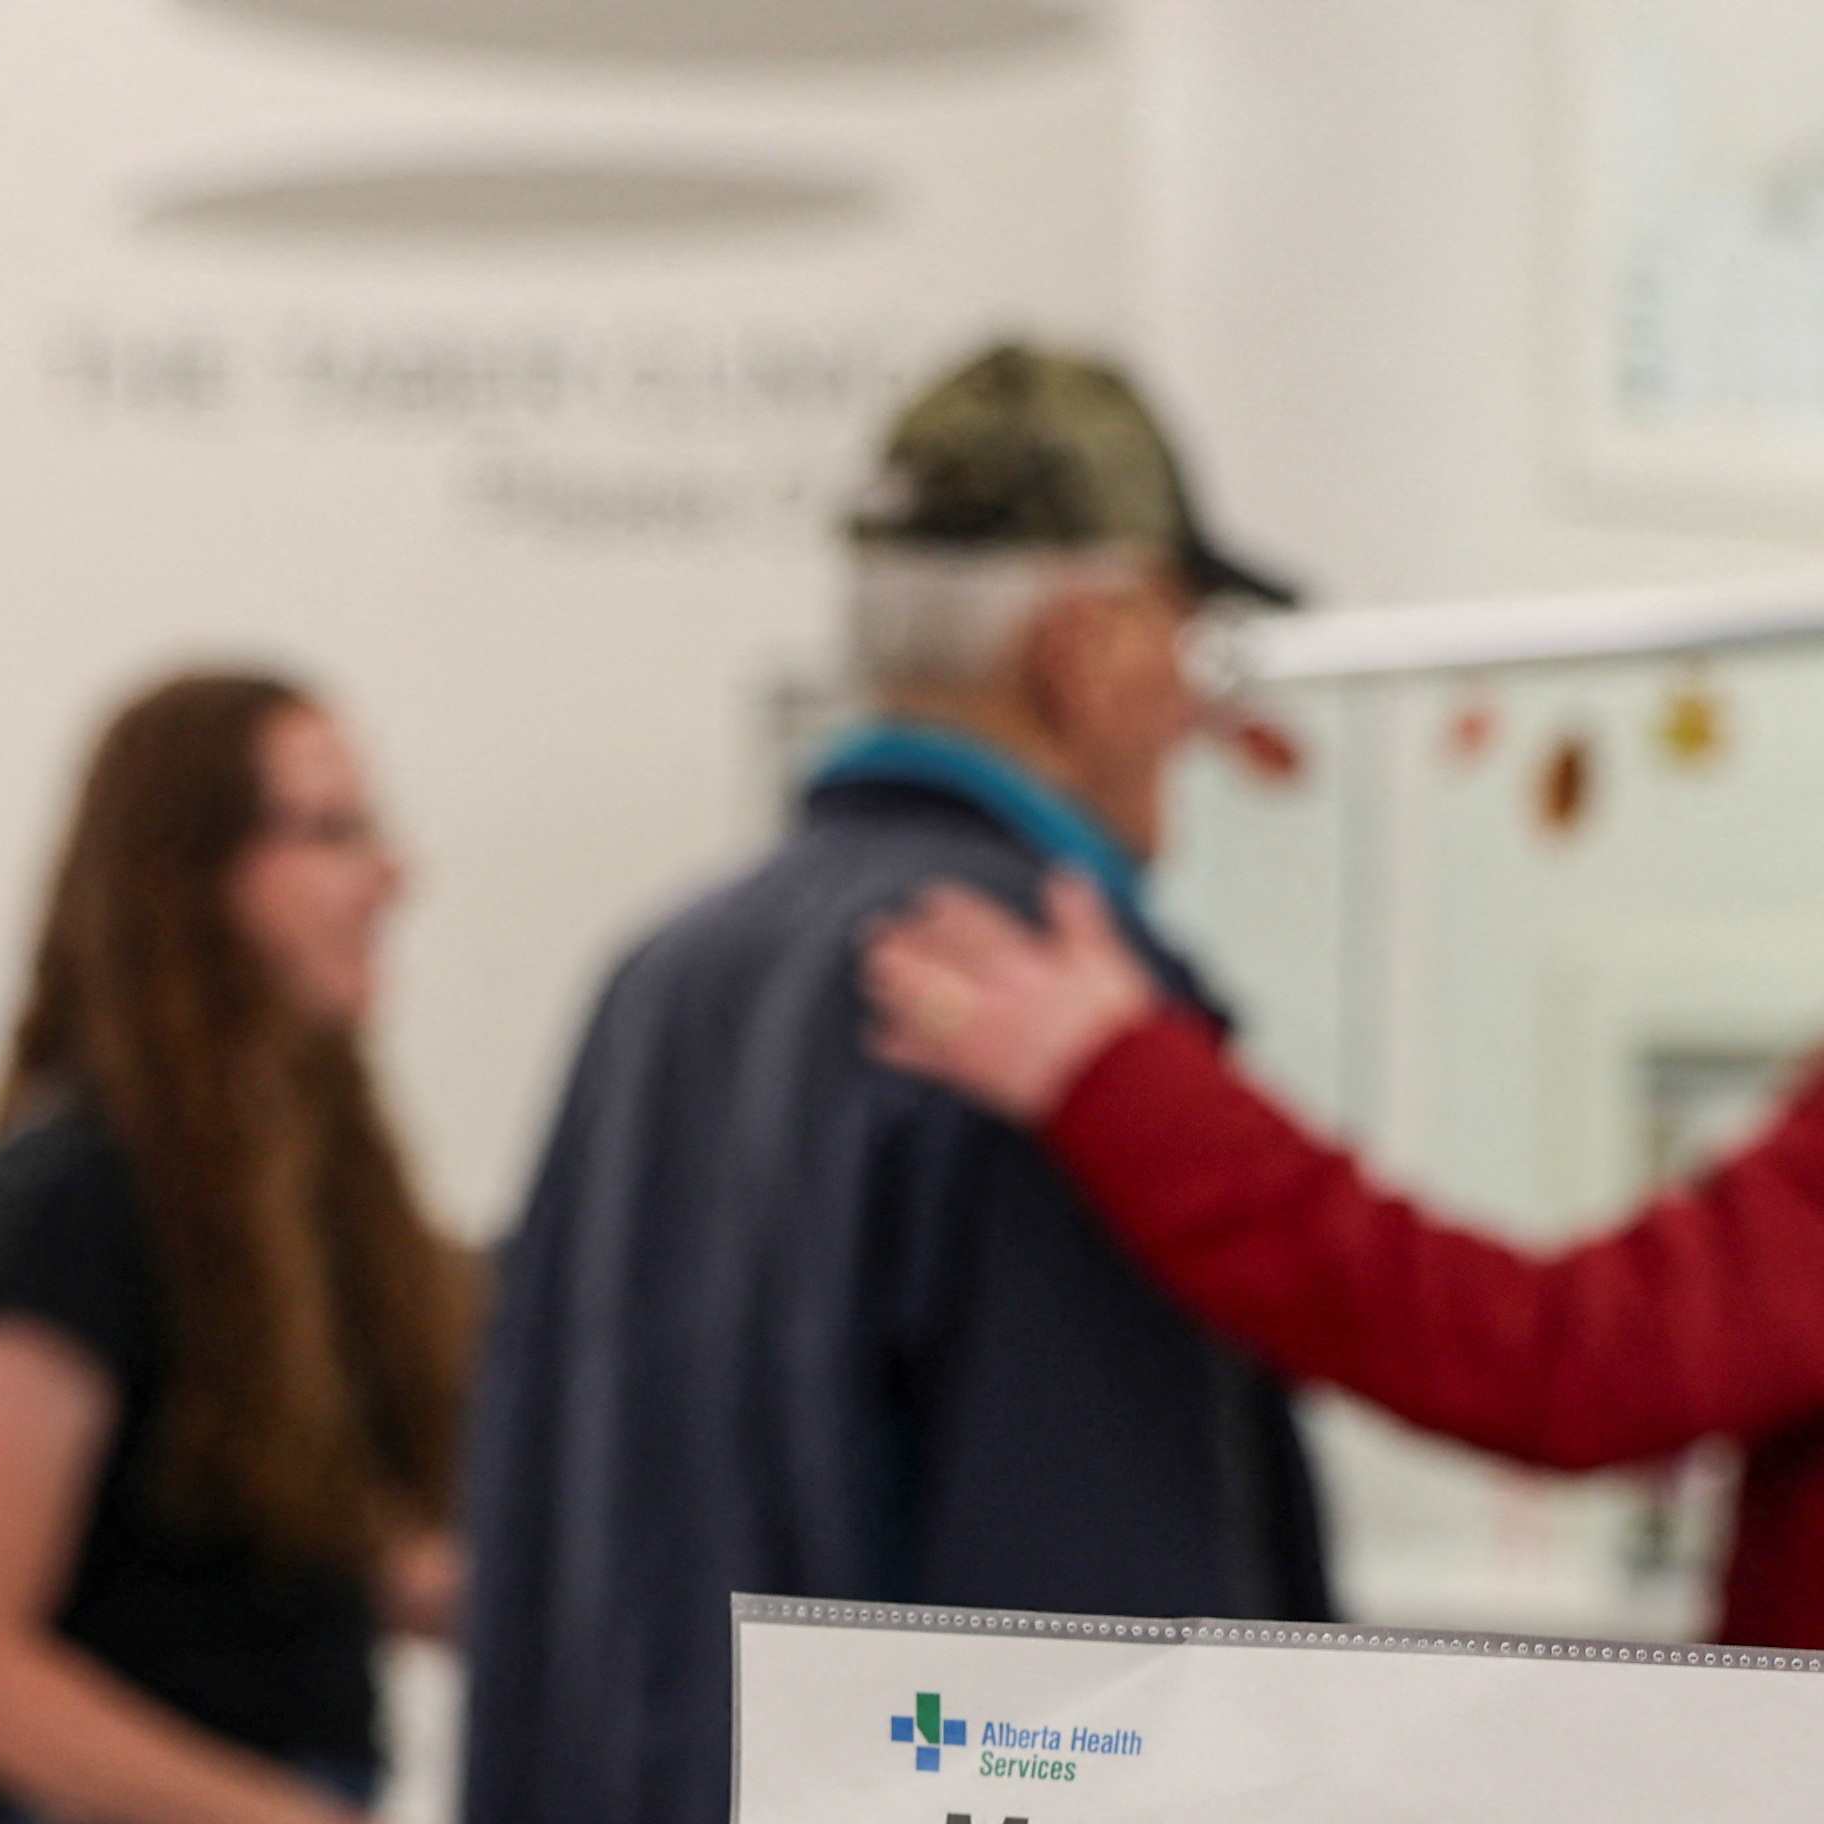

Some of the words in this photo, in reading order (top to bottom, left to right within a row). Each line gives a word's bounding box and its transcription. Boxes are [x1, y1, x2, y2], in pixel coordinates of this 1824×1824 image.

[981, 1719, 1063, 1754] Alberta
[1070, 1727, 1144, 1758] Health
[978, 1751, 1077, 1784] Services
